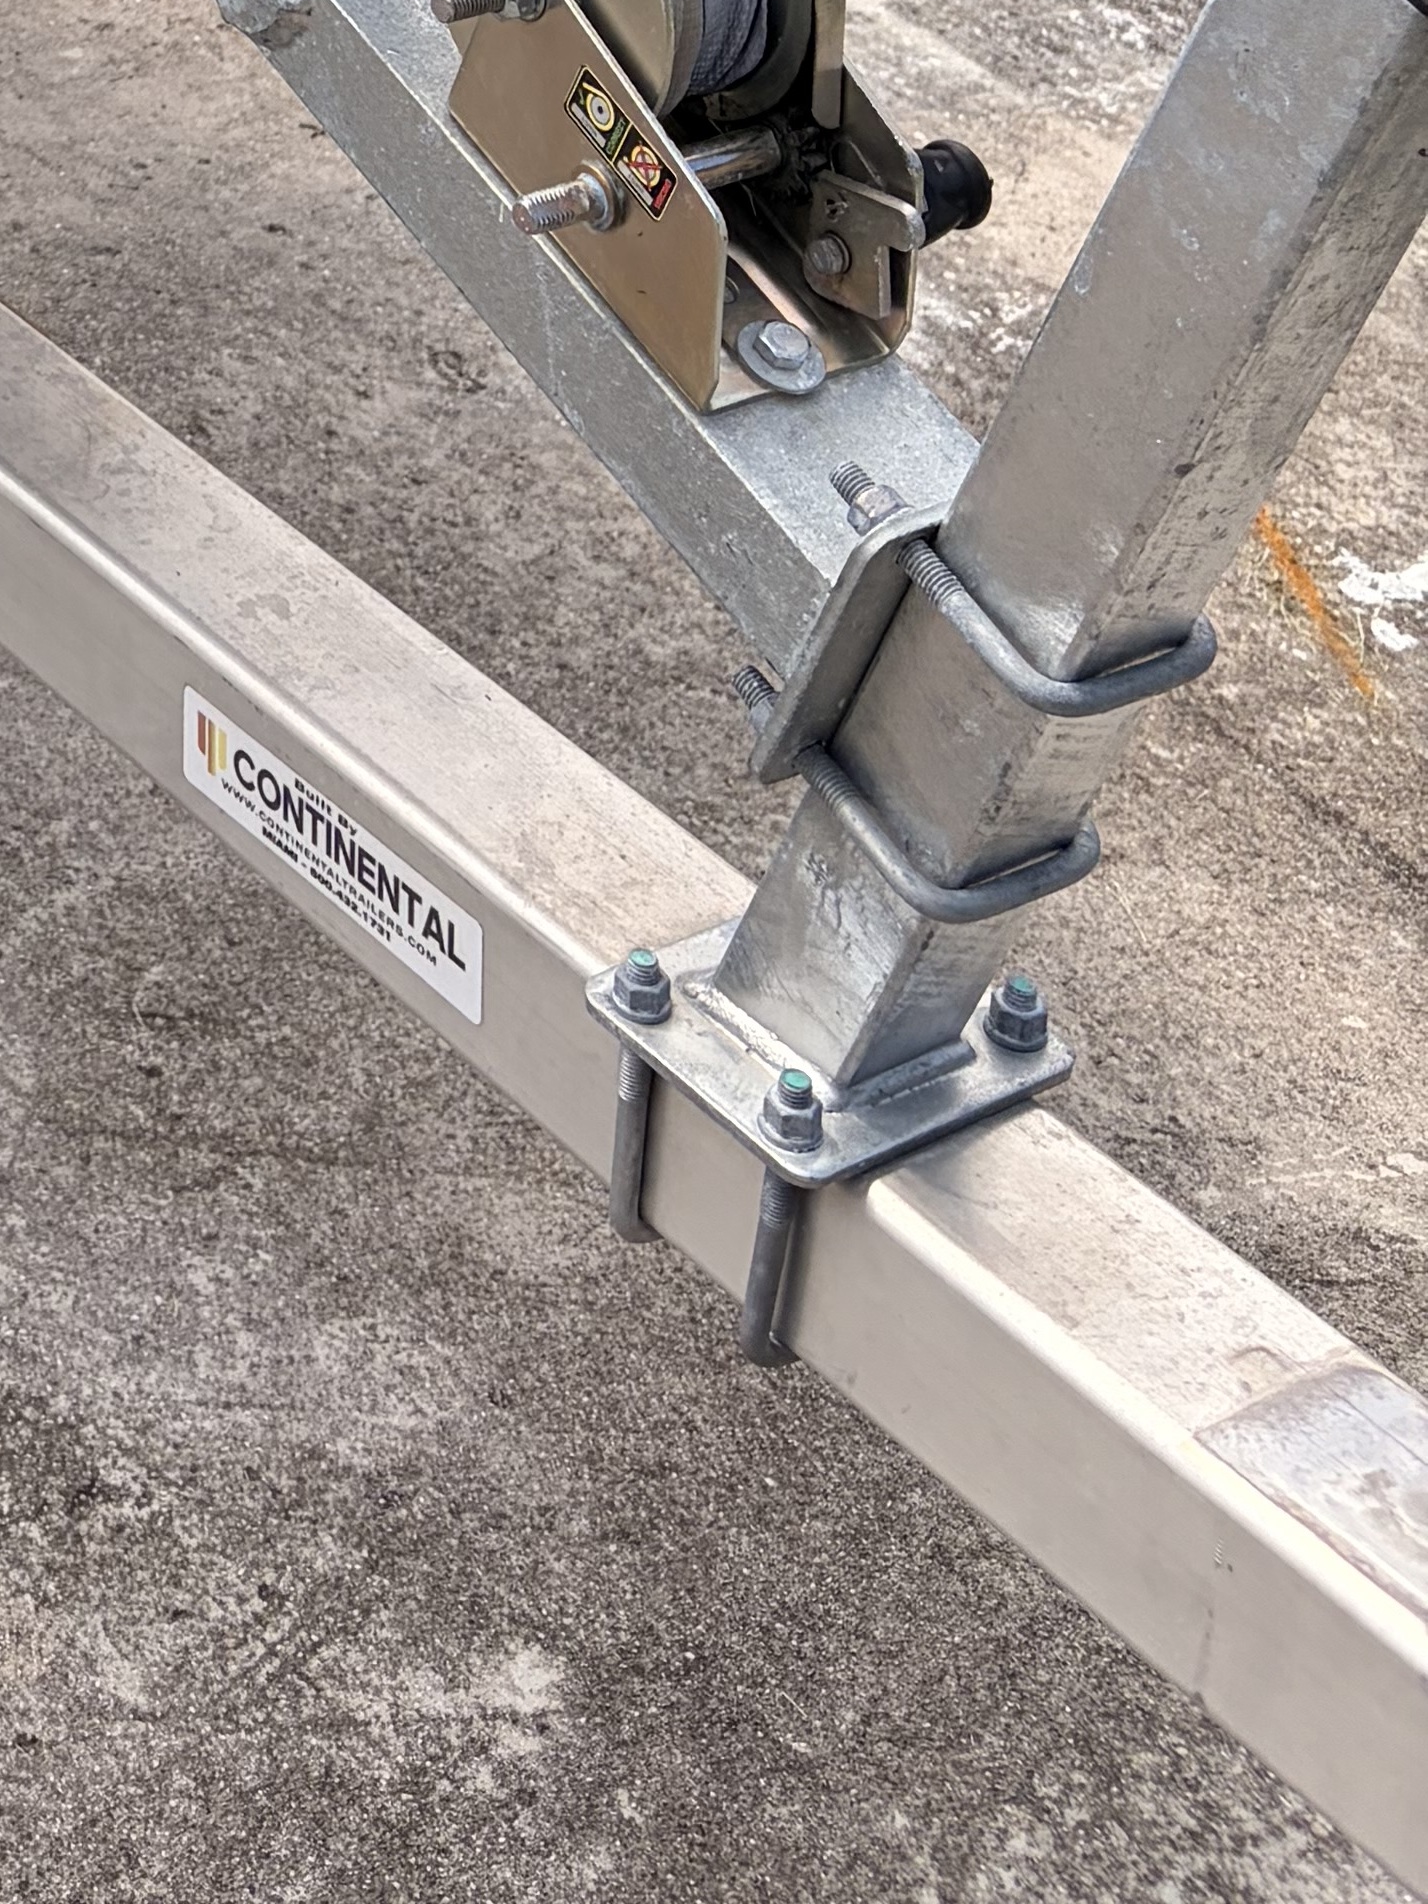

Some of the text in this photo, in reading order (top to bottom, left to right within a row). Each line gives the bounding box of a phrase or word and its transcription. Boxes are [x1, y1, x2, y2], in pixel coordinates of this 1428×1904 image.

[233, 749, 466, 972] CONTINENTAL
[261, 826, 298, 863] MIAMI
[294, 777, 358, 836] Built By
[221, 778, 437, 966] WWW.CONTINENTALTRAILERS.COM
